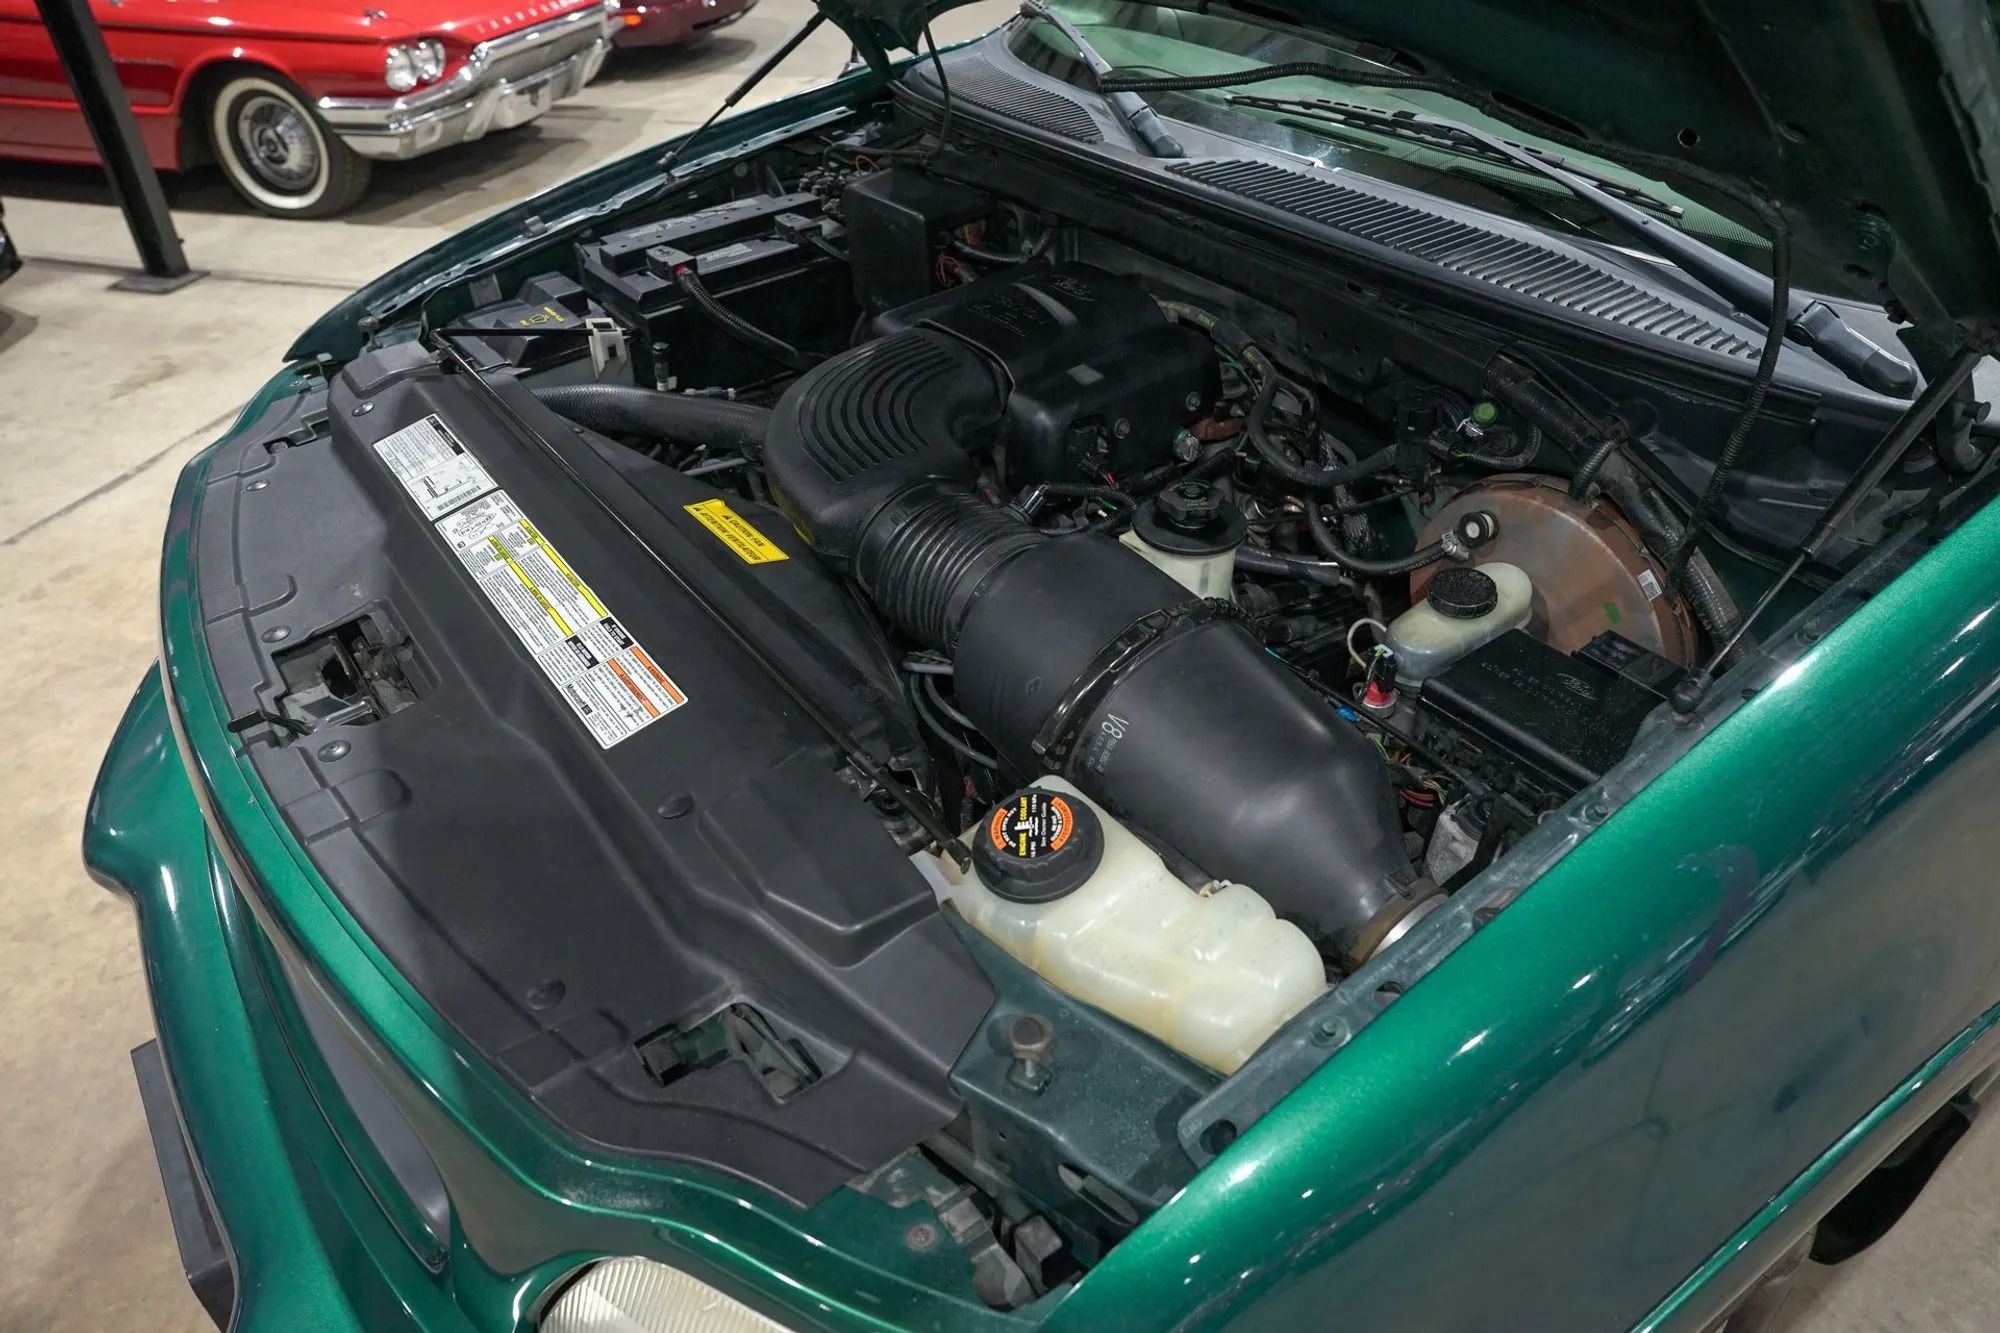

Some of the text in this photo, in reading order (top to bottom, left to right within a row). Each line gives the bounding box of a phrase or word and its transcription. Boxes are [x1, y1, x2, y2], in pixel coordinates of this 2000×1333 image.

[1101, 713, 1130, 739] V8
[993, 811, 1005, 840] WARNING
[1002, 832, 1010, 842] NOT
[1007, 807, 1017, 817] HOT
[1019, 832, 1027, 856] ENGINE
